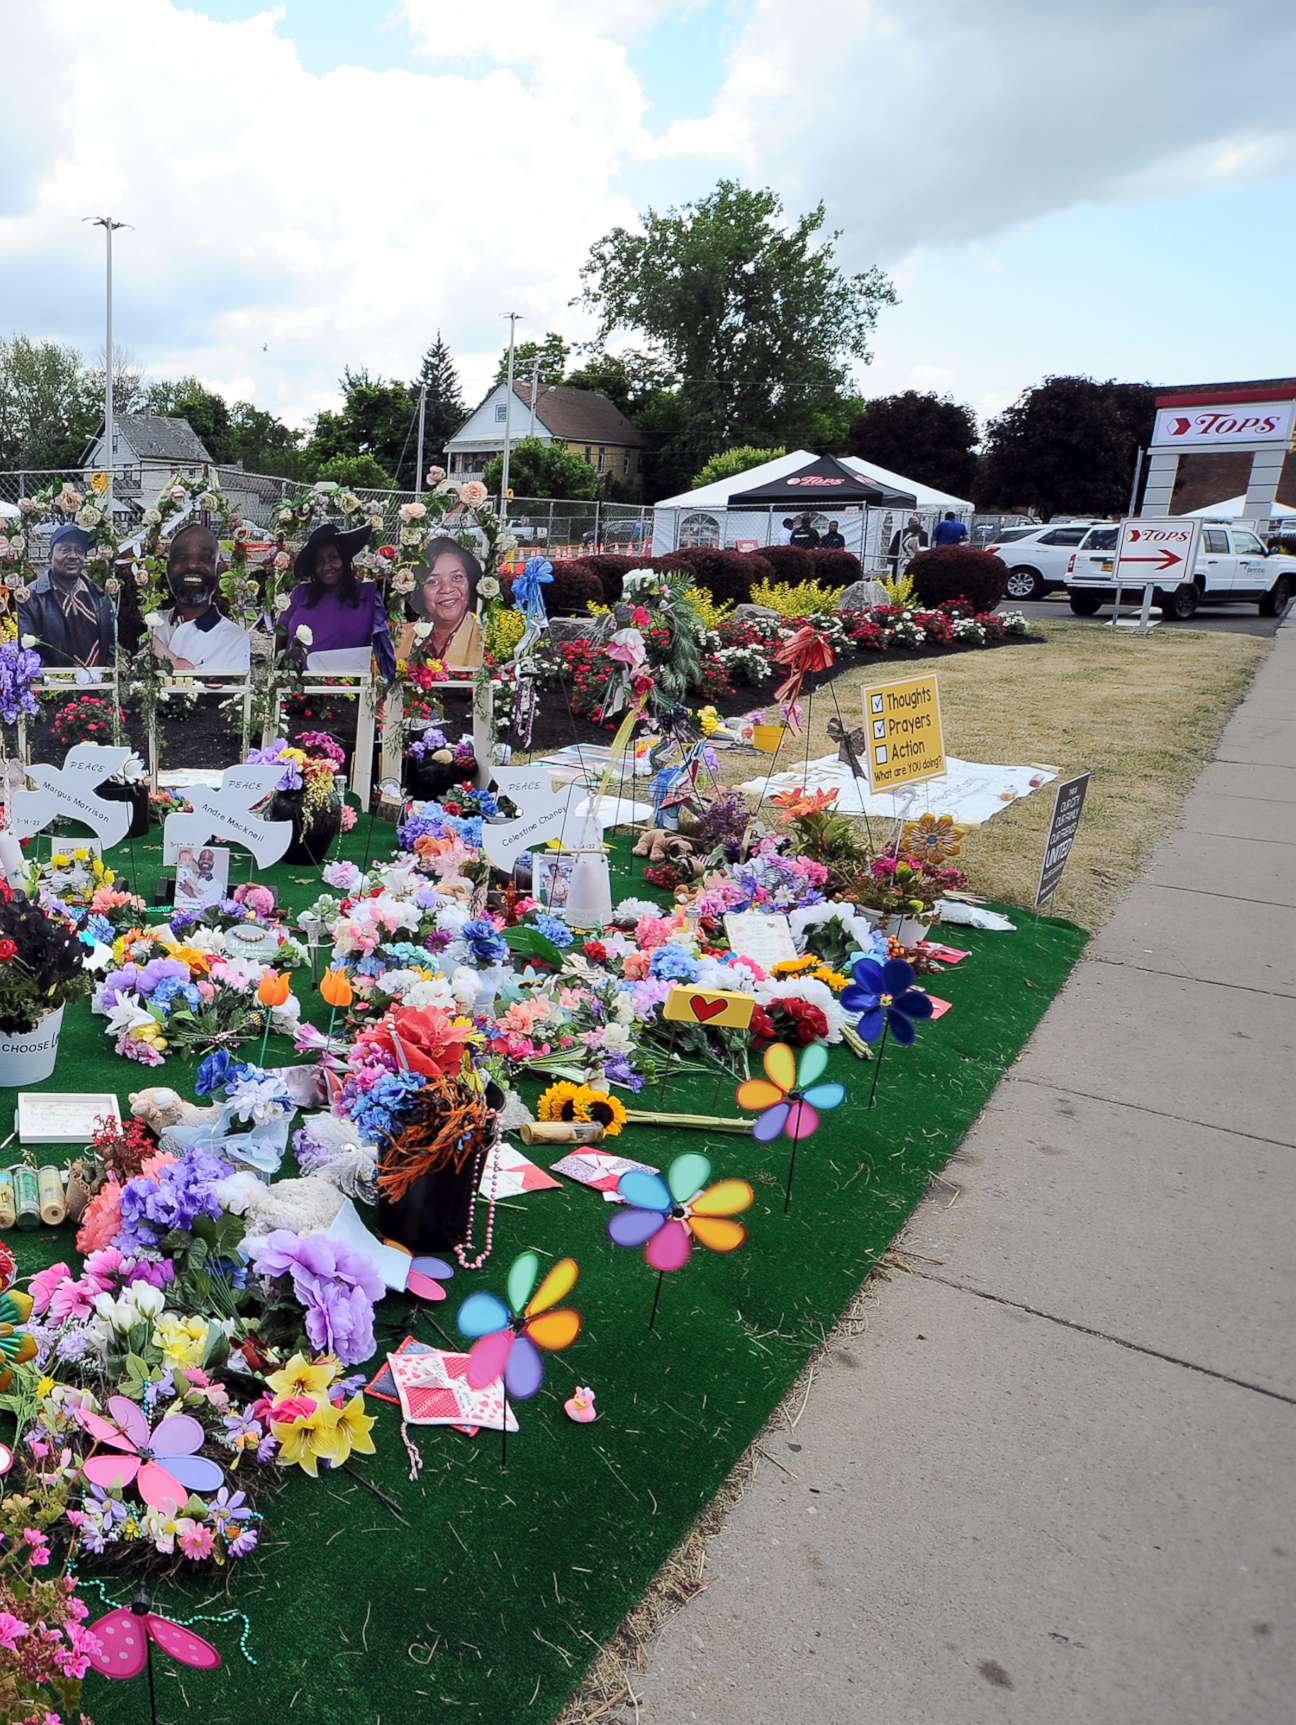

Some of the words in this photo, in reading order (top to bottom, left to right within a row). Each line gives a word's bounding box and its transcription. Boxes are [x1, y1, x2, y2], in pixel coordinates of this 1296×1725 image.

[1195, 413, 1280, 435] TOPS
[1142, 529, 1190, 542] TOPS
[887, 687, 932, 711] Thoughts
[889, 713, 932, 737] Prayers
[891, 740, 926, 761] Action
[70, 760, 106, 773] PEACE
[874, 768, 893, 782] What
[894, 766, 908, 776] are
[908, 760, 922, 775] YOU
[922, 755, 943, 773] doing?
[228, 779, 263, 791] PEACE
[508, 781, 541, 792] PEACE
[42, 780, 73, 803] Margus
[72, 796, 111, 824] Morrison
[201, 802, 226, 821] Andre
[502, 823, 538, 848] Celestine
[1, 1040, 49, 1054] CHOOSE
